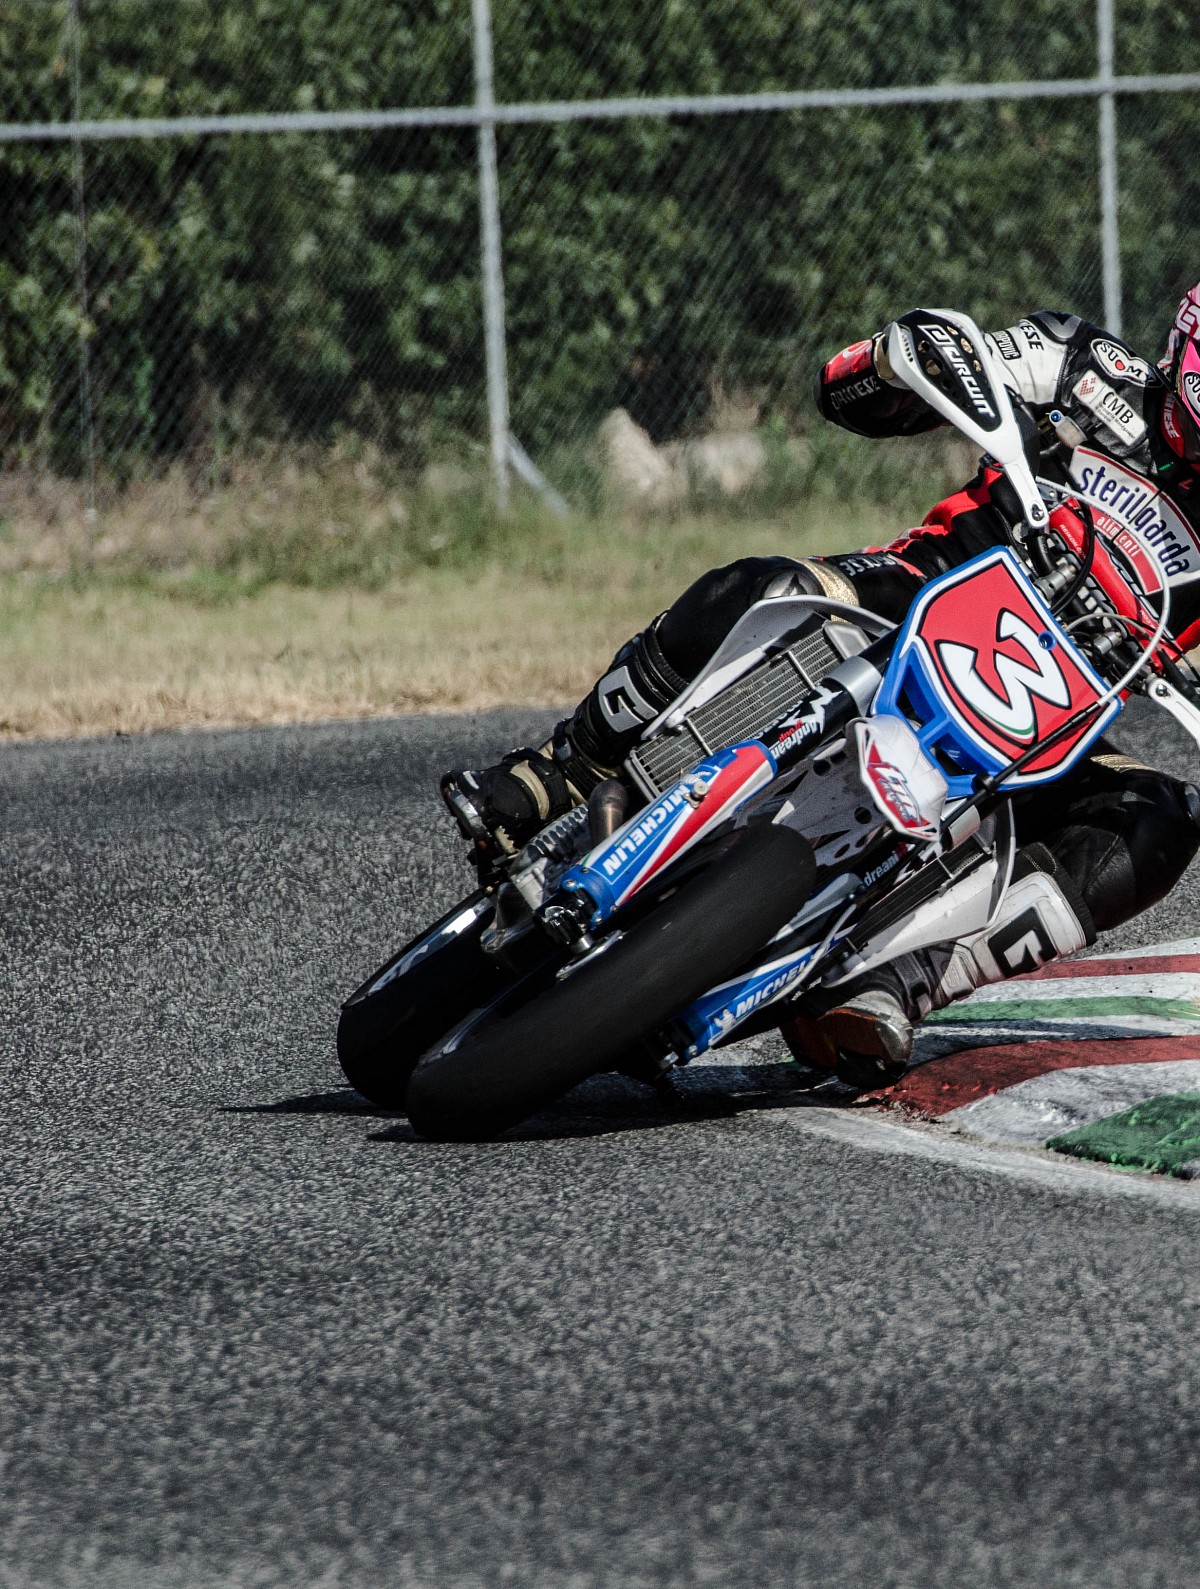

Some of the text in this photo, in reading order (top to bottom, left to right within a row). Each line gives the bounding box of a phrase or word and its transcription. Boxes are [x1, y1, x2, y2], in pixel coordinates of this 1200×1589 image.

[1101, 391, 1134, 424] CMB
[1081, 466, 1191, 577] sterilgarda
[935, 608, 1072, 748] 3
[771, 716, 818, 760] Andrean
[602, 784, 690, 876] MICHELIN
[735, 957, 808, 1019] MICHEL
